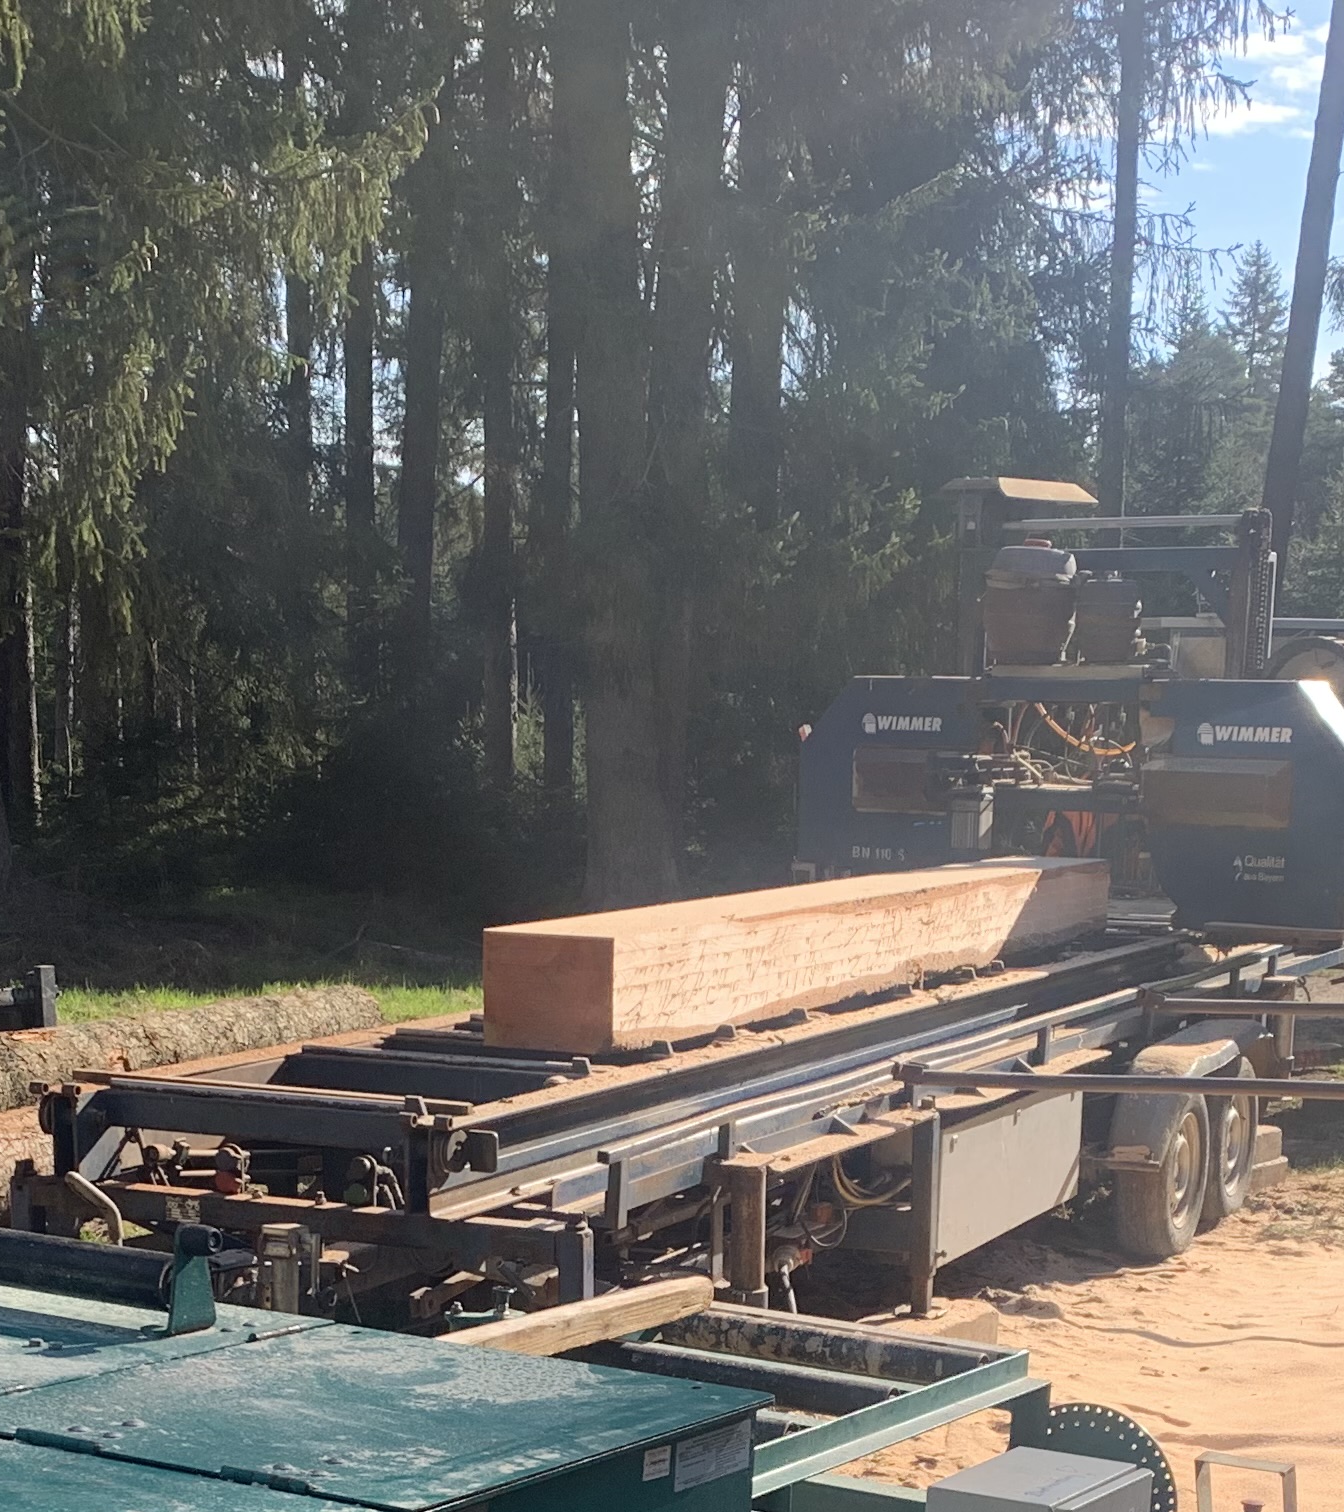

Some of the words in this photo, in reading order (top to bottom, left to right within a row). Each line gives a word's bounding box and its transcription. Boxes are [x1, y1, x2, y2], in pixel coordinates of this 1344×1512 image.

[877, 715, 943, 732] WIMMER
[1215, 725, 1293, 743] WIMMER
[852, 846, 871, 859] BN
[875, 847, 892, 861] 110
[1244, 854, 1286, 869] Qualität
